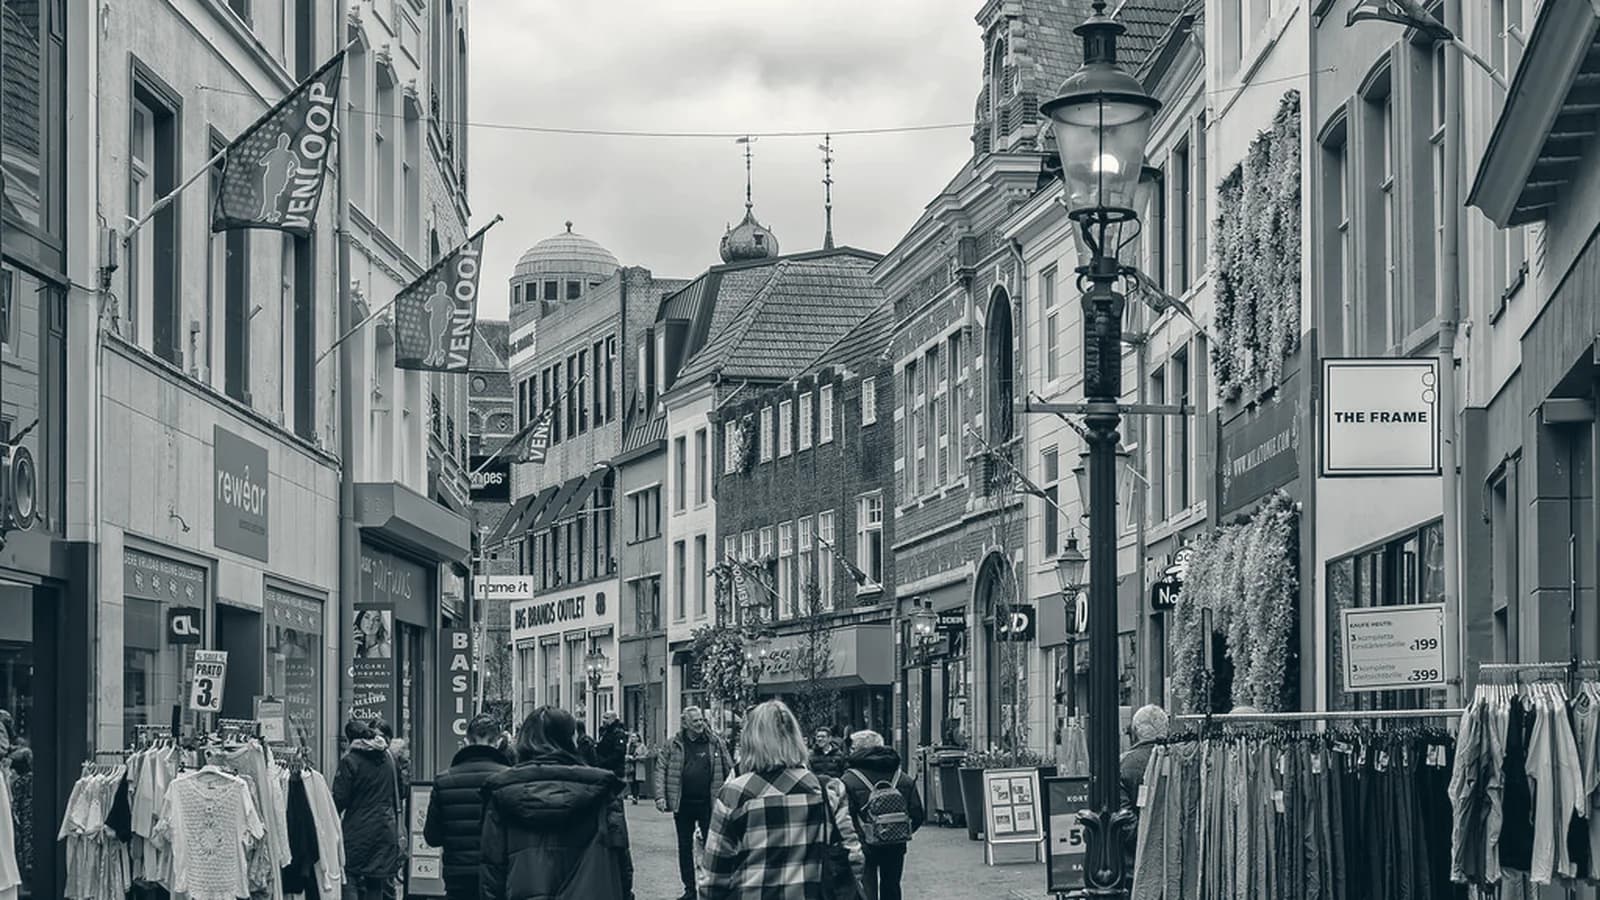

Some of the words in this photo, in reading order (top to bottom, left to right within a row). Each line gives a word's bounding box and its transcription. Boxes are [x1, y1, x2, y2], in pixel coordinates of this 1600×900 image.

[281, 82, 334, 227] VENLOOP
[447, 243, 479, 369] VENLOOP
[1334, 411, 1365, 423] THE
[1370, 411, 1428, 423] FRAME
[217, 468, 266, 516] rewear
[479, 583, 516, 593] name
[518, 580, 529, 593] it
[1159, 585, 1179, 605] No
[515, 607, 526, 630] BIG
[528, 601, 555, 628] BRANDS
[557, 595, 585, 622] OUTLET
[1351, 634, 1356, 642] 3
[1410, 638, 1437, 650] €199
[1352, 664, 1358, 672] 3
[1408, 669, 1438, 681] €399
[1060, 828, 1083, 847] -5
